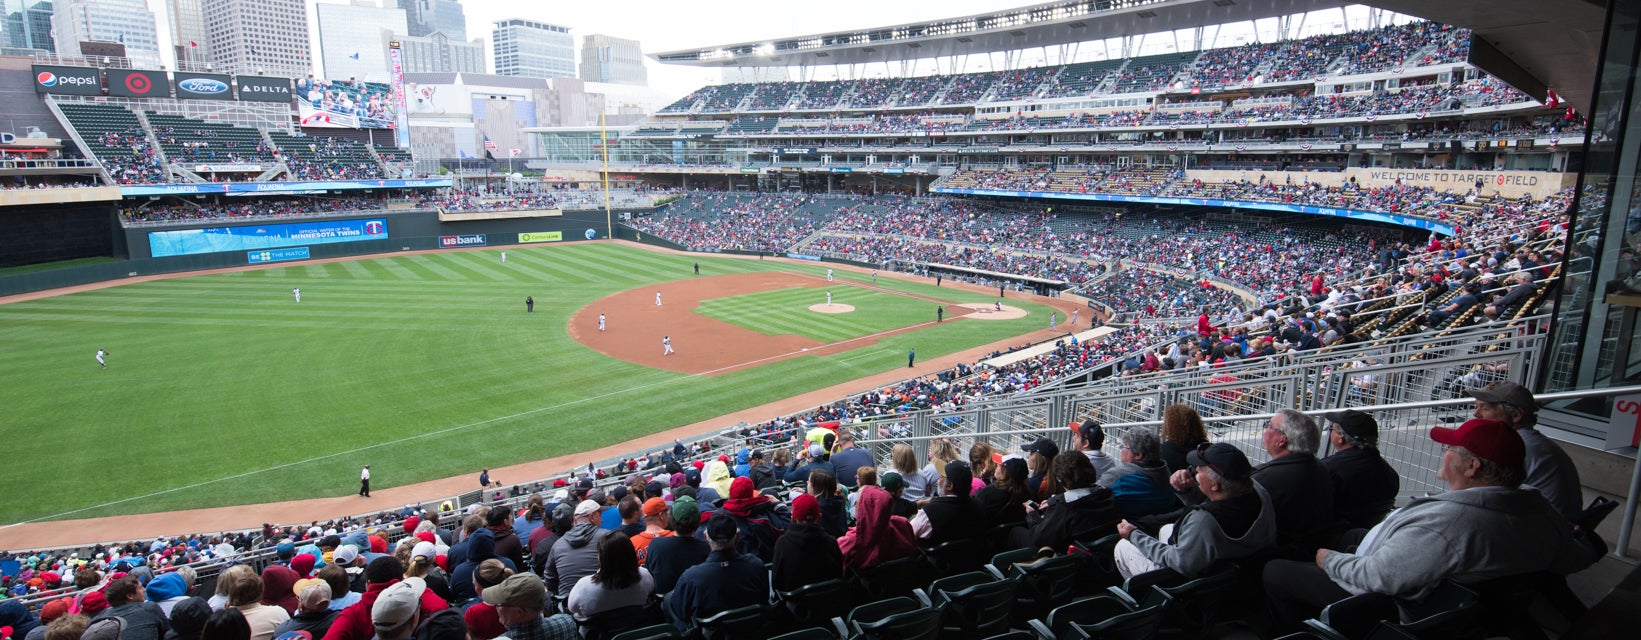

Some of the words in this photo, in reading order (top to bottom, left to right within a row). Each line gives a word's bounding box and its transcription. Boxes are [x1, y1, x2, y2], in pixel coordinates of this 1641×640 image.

[59, 75, 96, 87] pepsi
[189, 80, 219, 92] Ford
[253, 85, 289, 93] DELTA
[1371, 172, 1430, 182] WELCOME
[1434, 173, 1449, 182] TO
[1452, 174, 1496, 184] TARGET
[1505, 176, 1538, 186] FIELD
